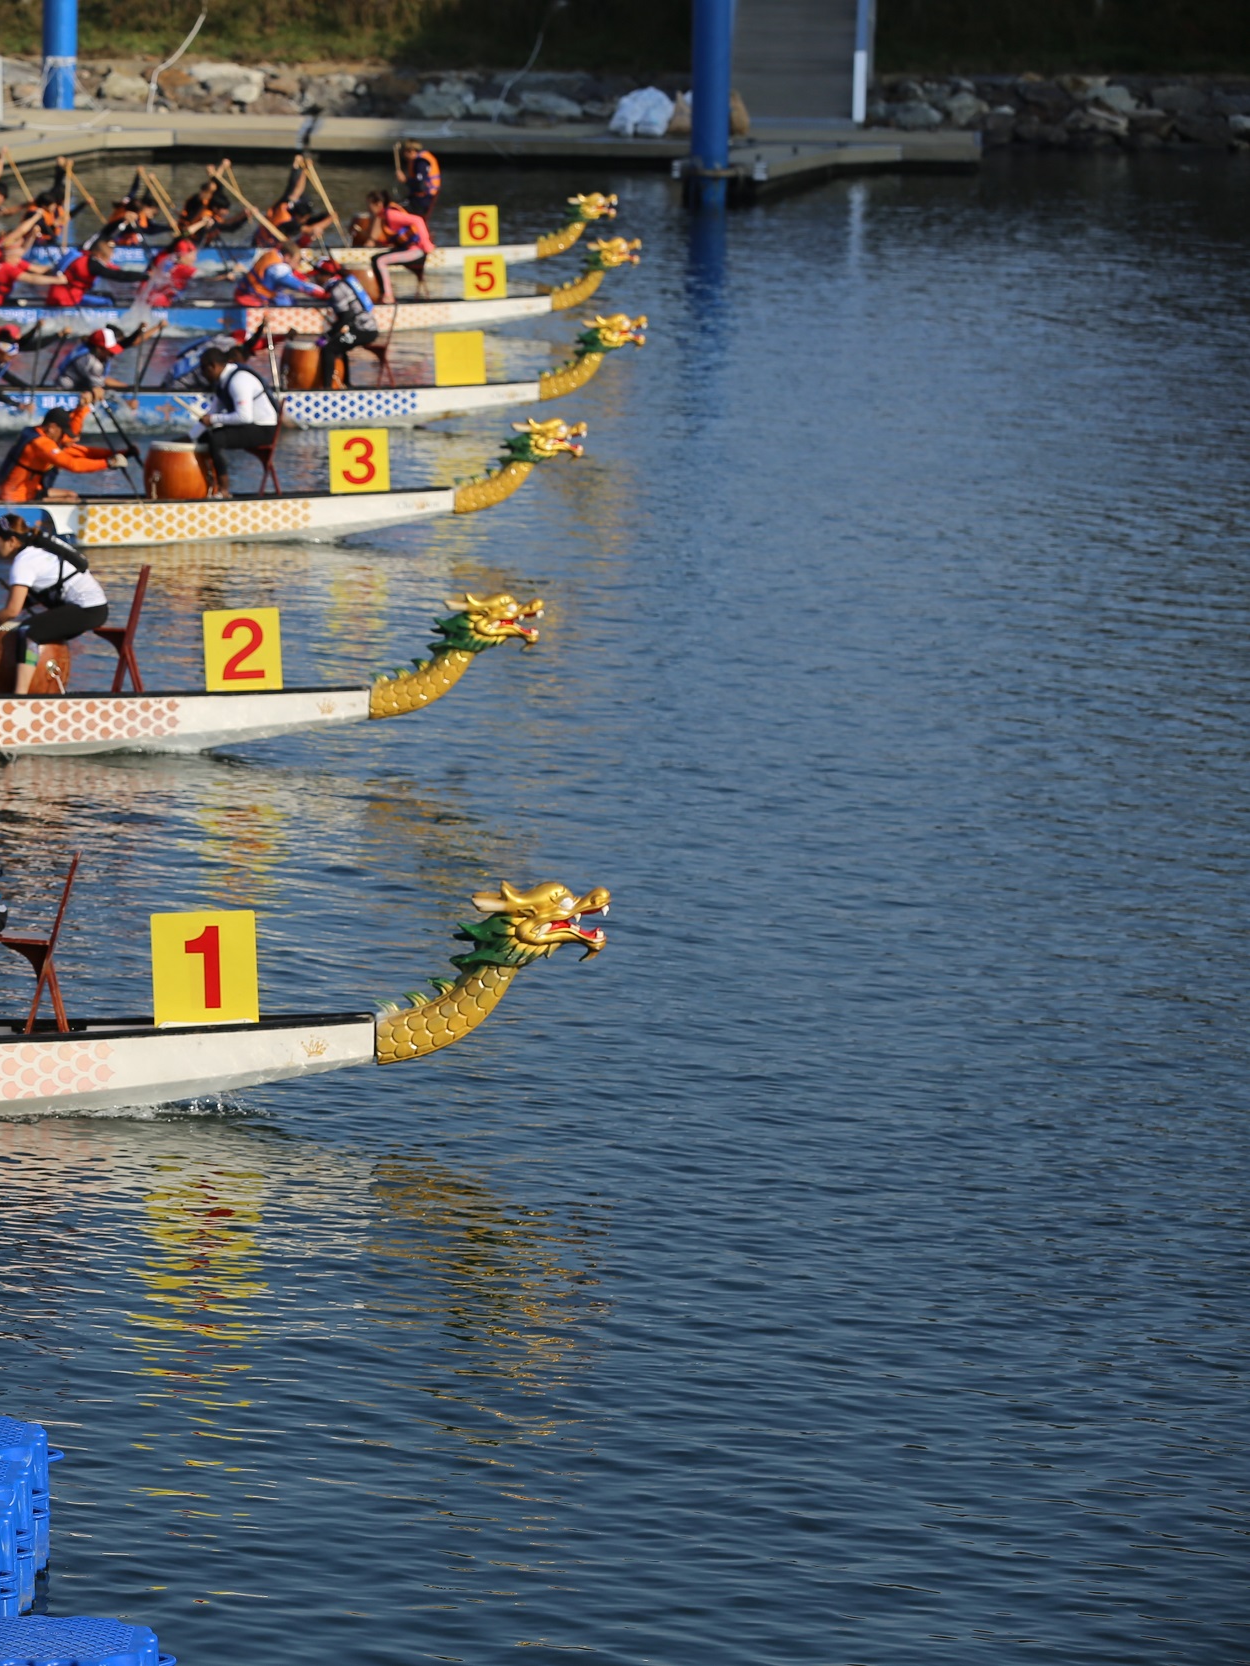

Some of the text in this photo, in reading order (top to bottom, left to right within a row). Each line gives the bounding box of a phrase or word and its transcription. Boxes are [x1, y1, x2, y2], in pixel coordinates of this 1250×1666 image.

[468, 212, 489, 241] 6
[474, 261, 495, 292] 5
[342, 437, 376, 485] 3
[221, 617, 266, 681] 2
[184, 925, 222, 1009] 1
